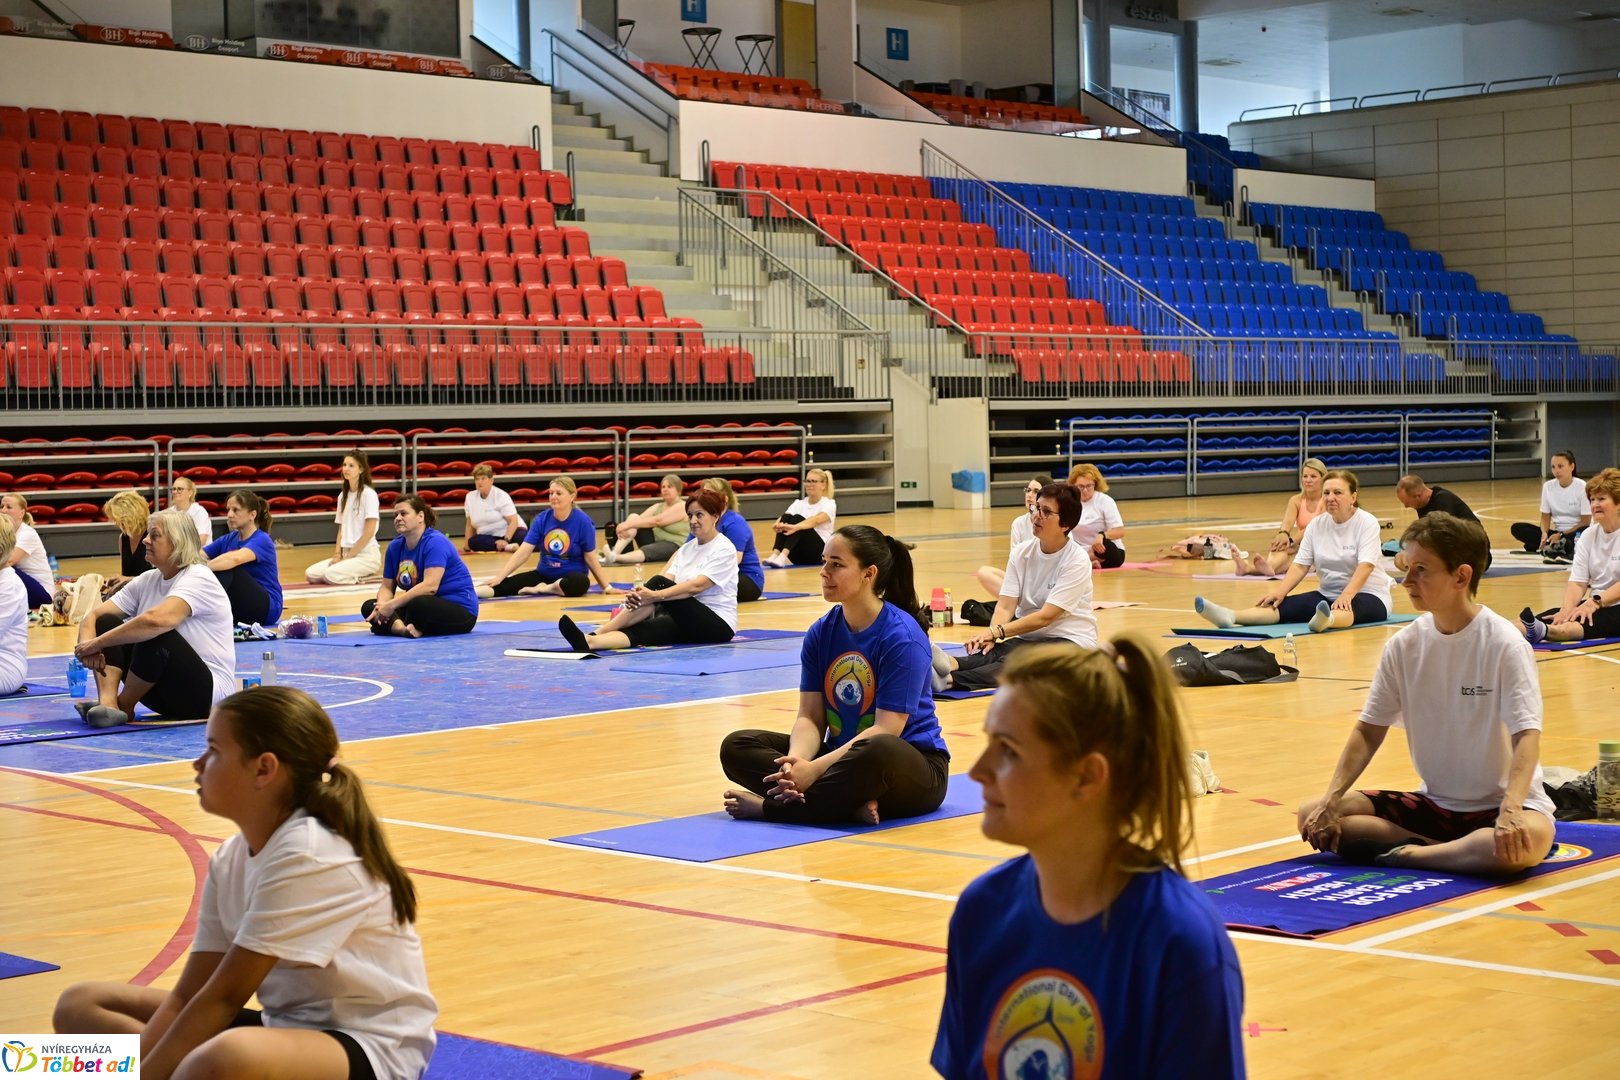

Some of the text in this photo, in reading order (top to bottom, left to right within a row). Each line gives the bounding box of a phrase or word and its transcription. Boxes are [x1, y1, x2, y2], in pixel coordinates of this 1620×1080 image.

[105, 29, 121, 41] BH
[189, 37, 205, 49] BH
[270, 44, 286, 56] BH
[346, 52, 361, 63] BH
[420, 60, 434, 71] BH
[830, 656, 855, 681] International
[856, 656, 864, 665] Day
[1462, 686, 1476, 696] tcs
[1278, 871, 1386, 900] ONE HEALTH
[1310, 875, 1418, 902] ONE EARTH,
[1342, 877, 1454, 906] YOGA FOR
[993, 981, 1095, 1063] International Day of Yoga
